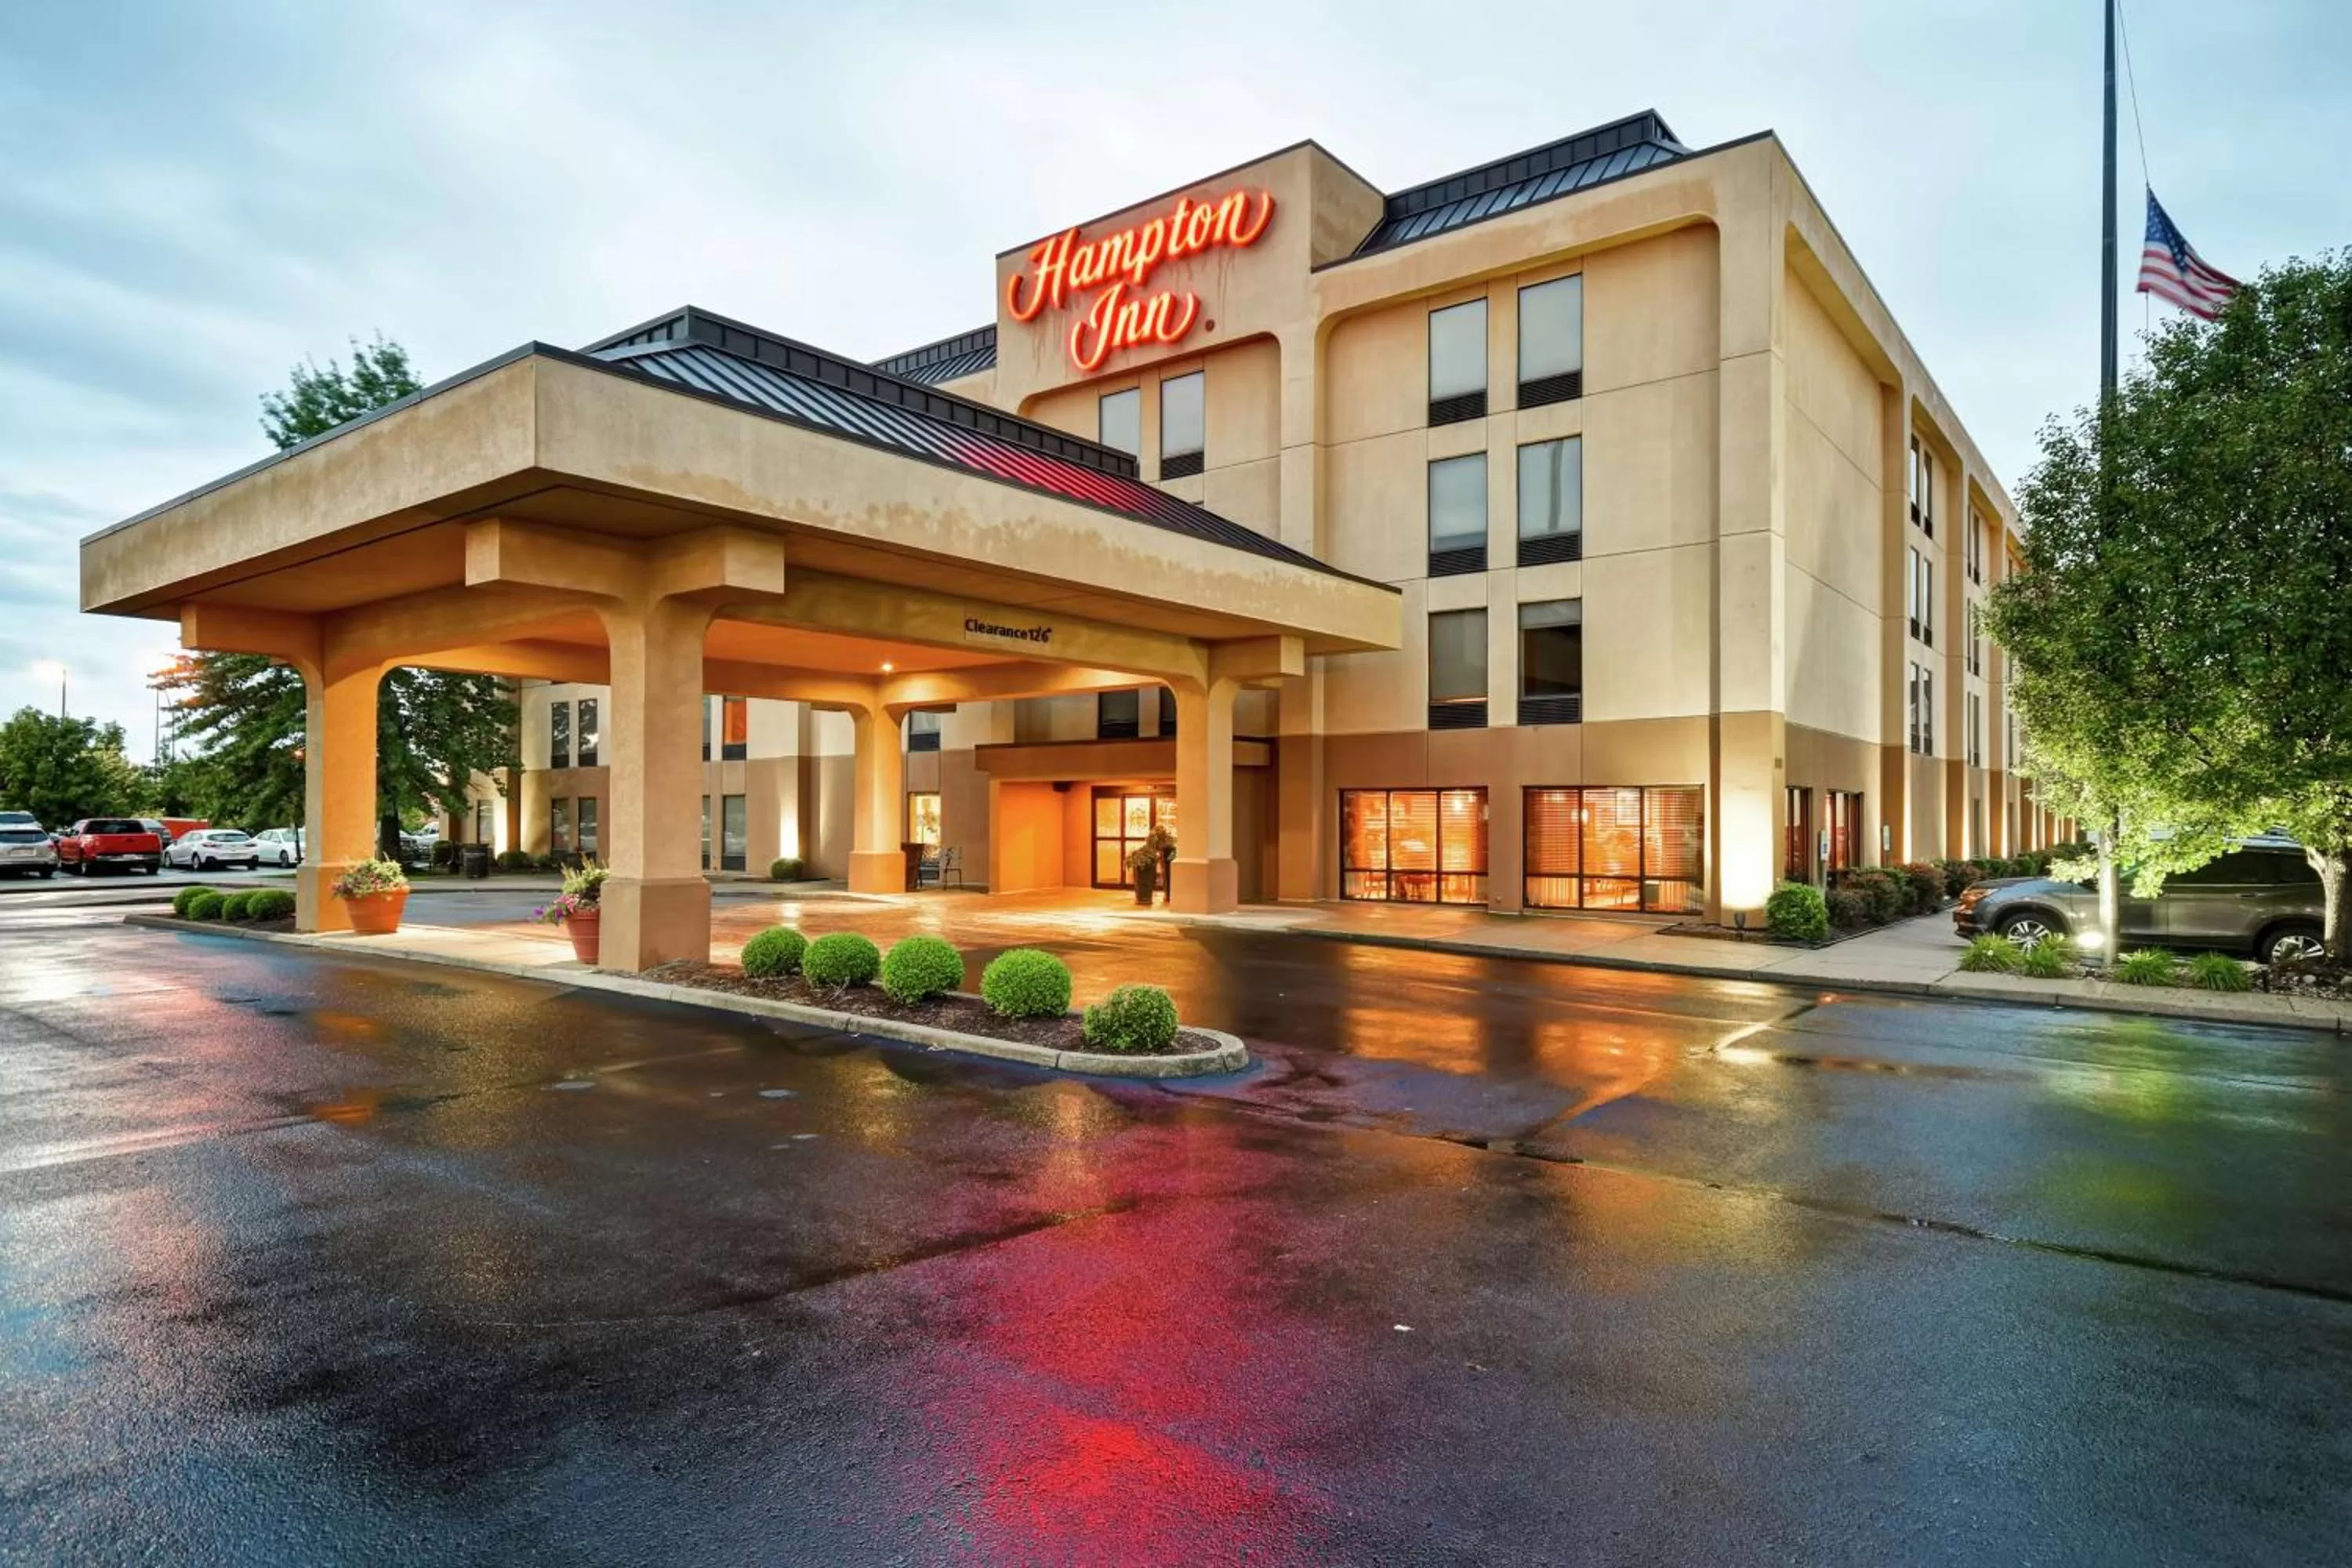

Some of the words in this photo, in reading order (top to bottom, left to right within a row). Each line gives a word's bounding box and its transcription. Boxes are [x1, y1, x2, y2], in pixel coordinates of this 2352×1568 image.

[1007, 191, 1275, 323] Hampton
[1069, 280, 1202, 371] Inn
[965, 618, 1027, 640] Clearance
